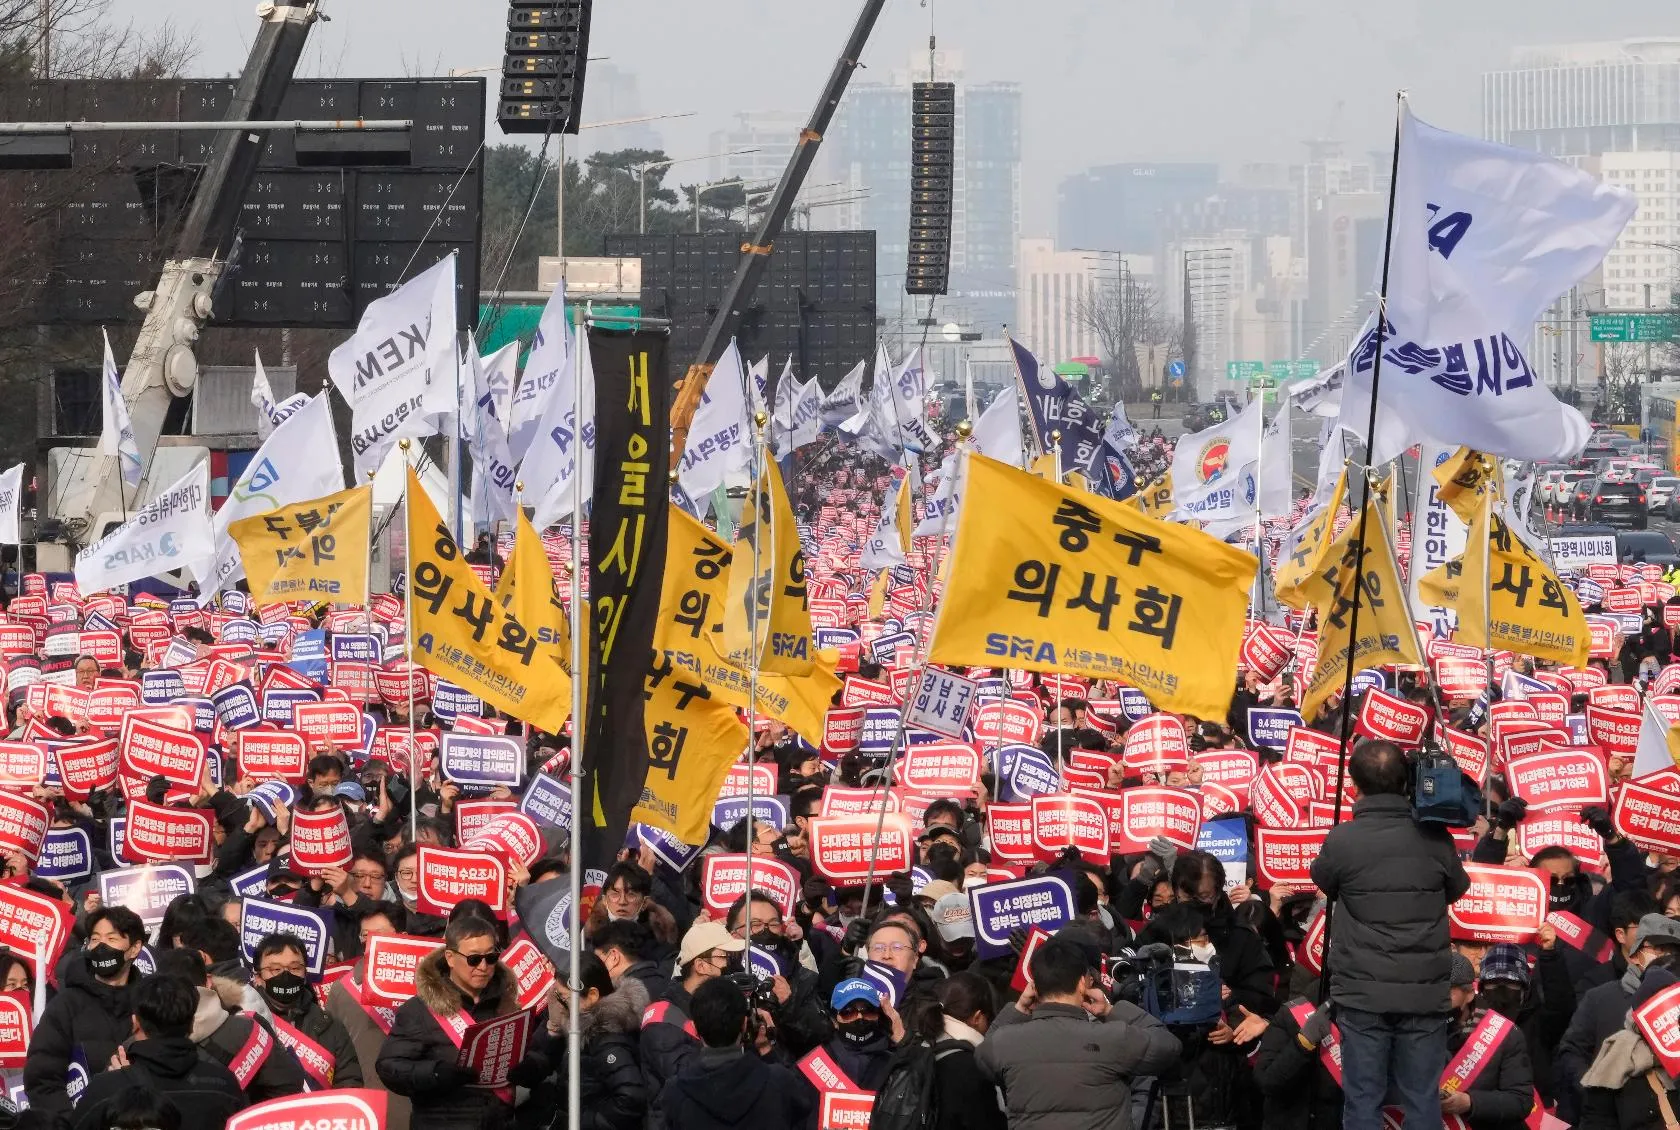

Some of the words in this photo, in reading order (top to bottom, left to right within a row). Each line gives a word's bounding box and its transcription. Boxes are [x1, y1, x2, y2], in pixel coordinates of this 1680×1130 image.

[1053, 498, 1162, 566] 중구
[1553, 540, 1613, 558] 구광역시의사회
[414, 562, 537, 667] 의사회
[1007, 560, 1183, 650] 의사회
[772, 632, 808, 660] SMA
[985, 632, 1058, 665] SMA
[1063, 647, 1179, 687] 서울특별시의사회
[437, 642, 527, 698] 서울특별시의사회
[924, 673, 971, 704] 강남구
[915, 695, 965, 725] 의사회
[1258, 719, 1269, 728] 9.4
[1255, 729, 1274, 740] 정부는
[131, 733, 163, 751] 의대정원
[164, 740, 198, 758] 졸속확대
[244, 743, 270, 754] 준비안된
[271, 743, 300, 755] 의대증원
[449, 746, 481, 759] 의료계와
[483, 748, 515, 761] 합의없는
[65, 757, 96, 772] 일방적인
[130, 746, 160, 765] 의료체계
[160, 753, 194, 773] 붕괴된다
[243, 754, 270, 765] 의학교육
[271, 754, 299, 767] 훼손된다
[448, 758, 481, 772] 의대증원
[481, 761, 515, 774] 결사반대
[1518, 766, 1556, 784] 비과학적
[1558, 761, 1596, 778] 수요조사
[1529, 783, 1549, 796] 즉각
[1551, 777, 1589, 793] 폐기하라
[535, 786, 564, 810] 의료계와
[1625, 797, 1661, 817] 비과학적
[527, 799, 557, 822] 의대증원
[1038, 810, 1066, 823] 일방적인
[1130, 801, 1165, 815] 의대정원
[1167, 802, 1196, 820] 졸속확대
[135, 815, 165, 831] 의대정원
[167, 821, 202, 835] 졸속확대
[994, 818, 1021, 832] 의대정원
[1038, 823, 1068, 837] 국민건강
[1130, 815, 1165, 829] 의료체계
[1167, 816, 1194, 834] 붕괴된다
[1527, 820, 1562, 834] 의대정원
[1630, 814, 1649, 828] 즉각
[133, 829, 165, 847] 의료체계
[166, 833, 202, 848] 붕괴된다
[822, 832, 861, 848] 의대정원
[994, 832, 1022, 846] 의료체계
[1526, 833, 1562, 848] 의료체계
[1564, 834, 1599, 850] 붕괴된다
[822, 848, 861, 863] 의료체계
[1265, 843, 1300, 856] 일방적인
[52, 853, 83, 868] 이행하라
[1266, 857, 1300, 871] 국민건강
[427, 862, 457, 879] 비과학적
[459, 867, 498, 882] 수요조사
[754, 870, 790, 890] 졸속확대
[433, 879, 449, 894] 즉각
[450, 880, 488, 897] 폐기하라
[1496, 884, 1538, 902] 의대증원
[993, 899, 1011, 914] 9.4
[1012, 888, 1053, 911] 의정합의
[1454, 899, 1493, 914] 의학교육
[1495, 901, 1537, 918] 훼손된다
[245, 914, 276, 933] 의료계와
[990, 912, 1020, 931] 정부는
[1021, 907, 1062, 926] 이행하라
[377, 950, 417, 970] 준비안된
[375, 968, 415, 986] 의학교육
[1455, 1039, 1489, 1080] 정책추진
